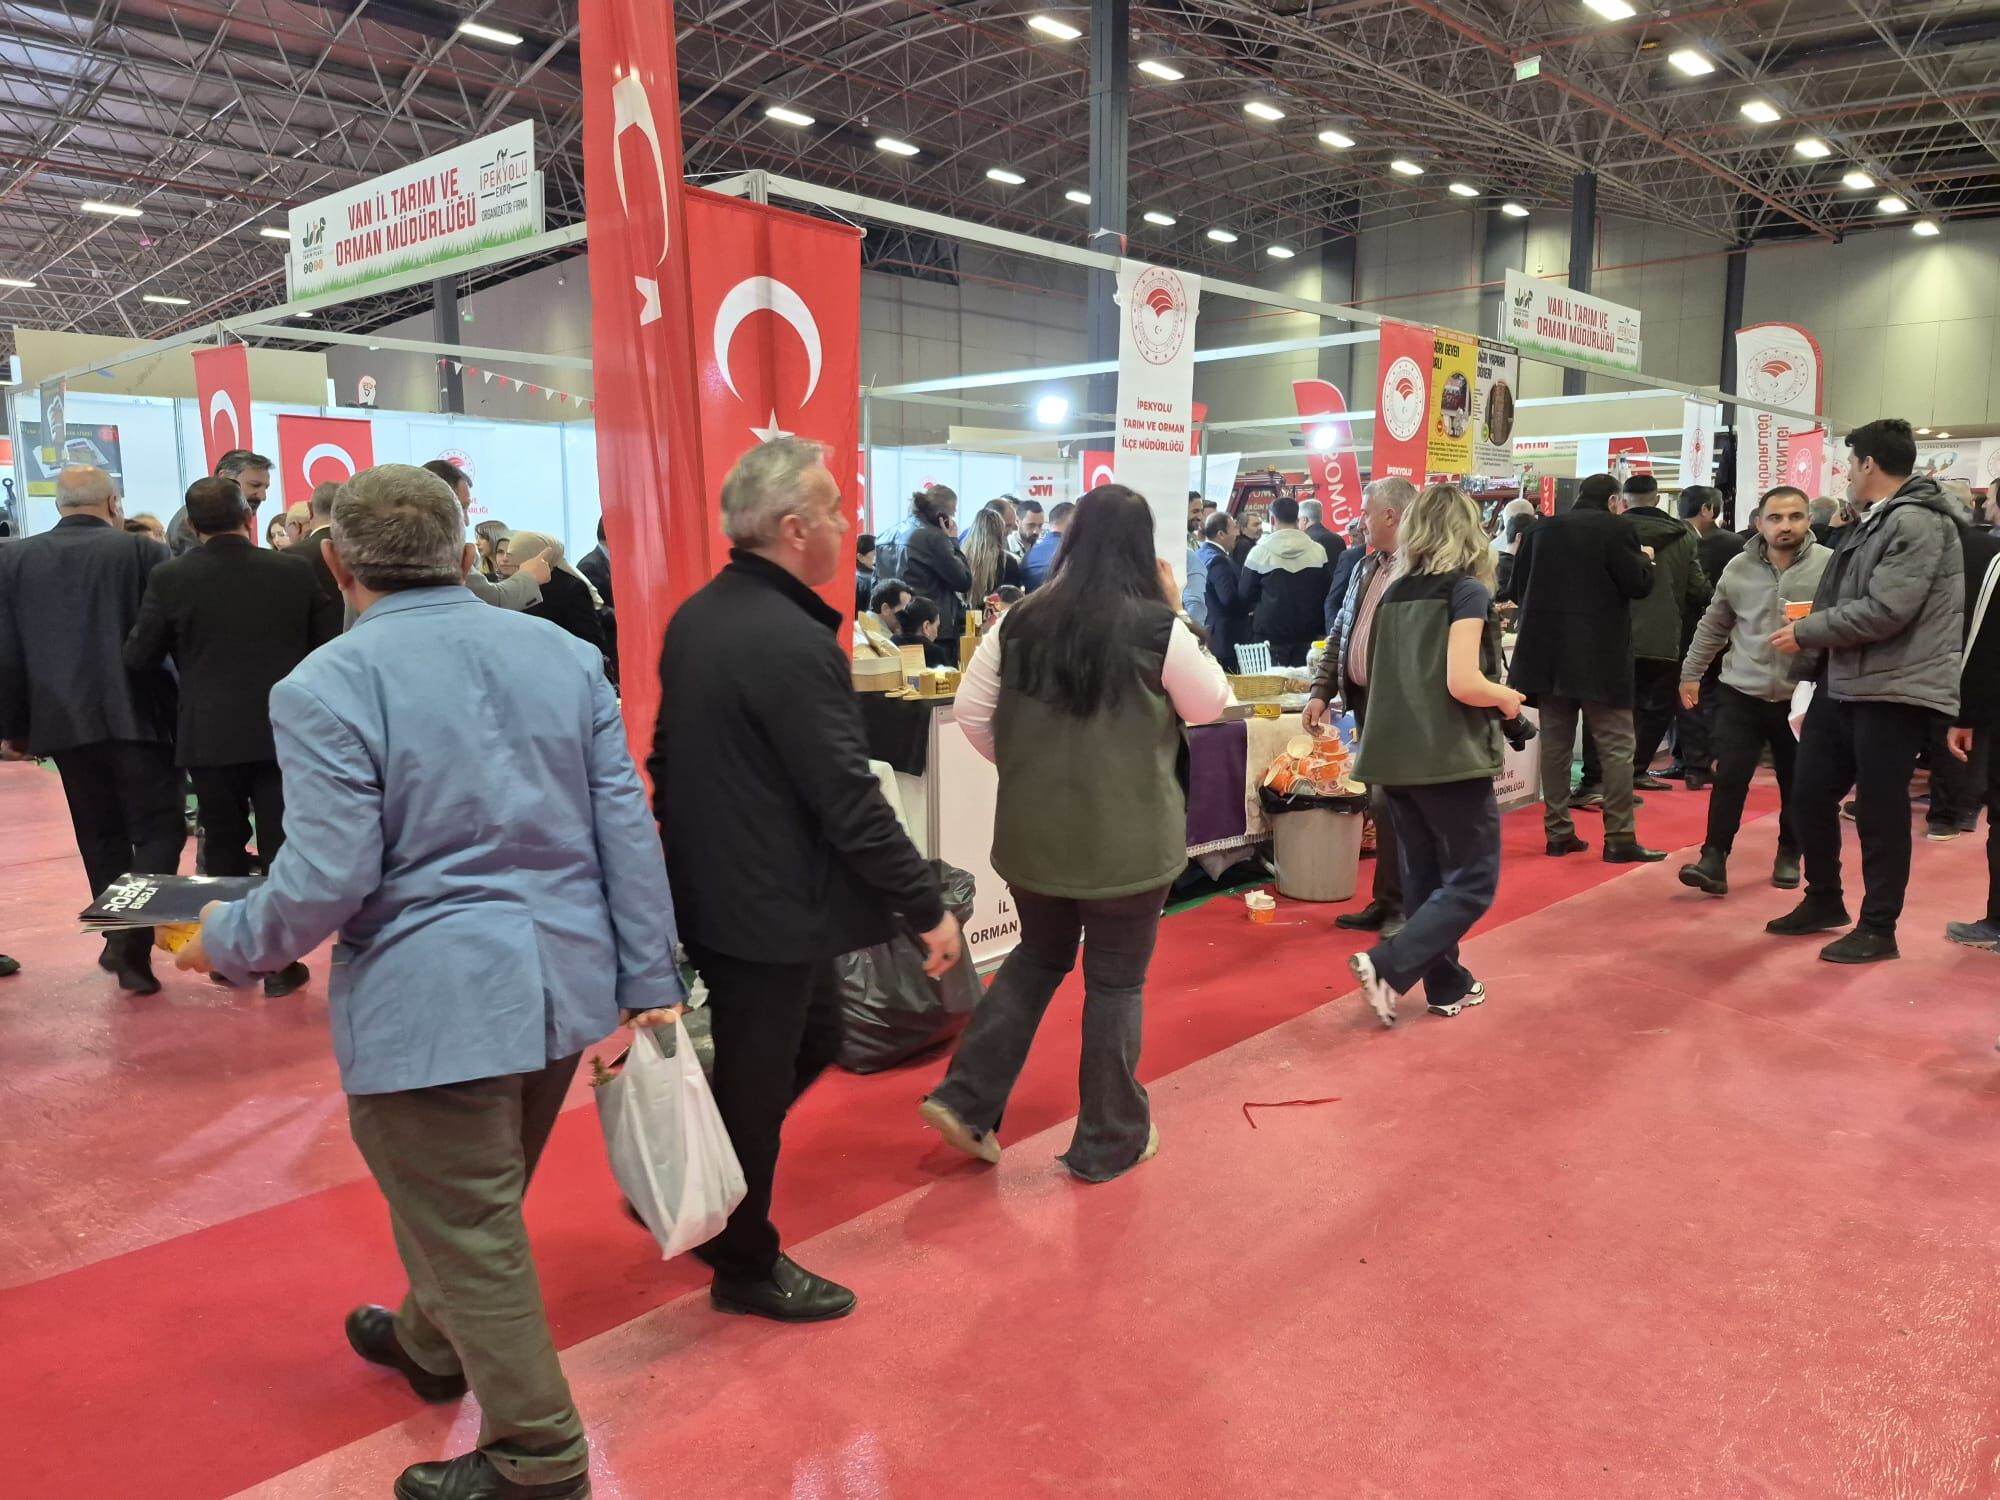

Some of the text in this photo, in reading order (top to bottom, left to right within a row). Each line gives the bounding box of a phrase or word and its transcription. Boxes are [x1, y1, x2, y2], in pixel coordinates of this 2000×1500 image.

[480, 159, 528, 191] İPEKYOLU
[348, 167, 459, 231] VAN İL TARIM VE
[495, 183, 511, 198] EXPO
[335, 191, 476, 267] ORMAN MÜDÜRLÜĞÜ
[1547, 295, 1562, 318] VAN
[1565, 297, 1572, 320] İL
[1574, 303, 1597, 328] TARIM
[1599, 311, 1608, 330] VE
[1536, 316, 1567, 342] ORMAN
[1569, 323, 1615, 353] MÜDÜRLÜĞÜ
[1137, 396, 1173, 413] İPEKYOLU
[1123, 418, 1185, 434] TARIM VE ORMAN
[1122, 434, 1185, 453] İLÇE MÜDÜRLÜĞÜ
[998, 898, 1010, 915] İL
[970, 919, 1018, 945] ORMAN
